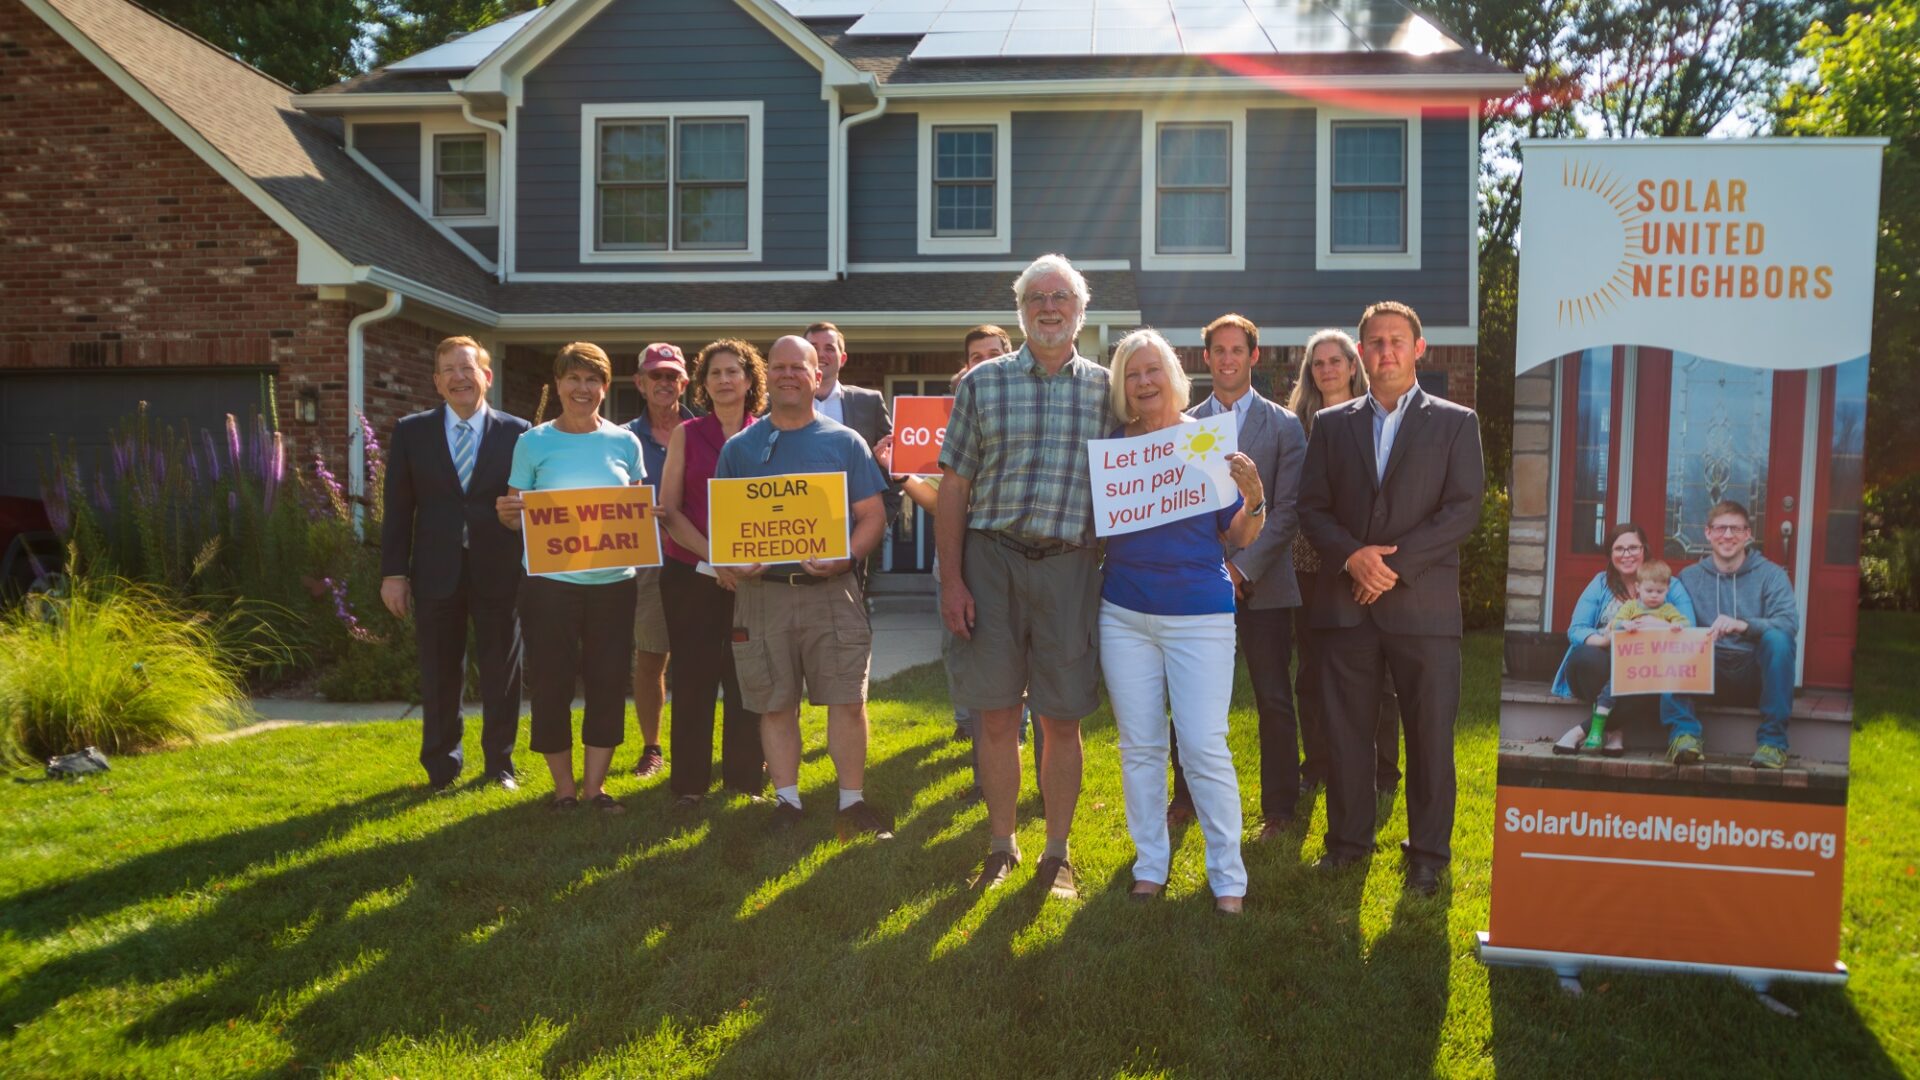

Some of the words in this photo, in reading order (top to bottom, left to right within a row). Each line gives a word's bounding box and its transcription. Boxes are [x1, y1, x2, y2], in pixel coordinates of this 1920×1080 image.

[1637, 179, 1747, 213] SOLAR
[1642, 222, 1765, 256] UNITED
[1632, 264, 1833, 299] NEIGHBORS
[901, 427, 930, 446] GO
[1104, 450, 1137, 469] Let
[1143, 441, 1174, 463] the
[746, 479, 808, 500] SOLAR
[1106, 479, 1144, 497] sun
[1151, 464, 1185, 493] pay
[529, 506, 570, 526] WE
[575, 502, 649, 523] WENT
[1108, 502, 1155, 529] your
[1160, 482, 1206, 515] bills!
[740, 518, 818, 539] ENERGY
[546, 532, 639, 555] SOLAR!
[732, 537, 826, 559] FREEDOM
[1617, 642, 1645, 657] WE
[1626, 664, 1697, 679] SOLAR!
[1504, 806, 1836, 859] SolarUnitedNeighbors.org
